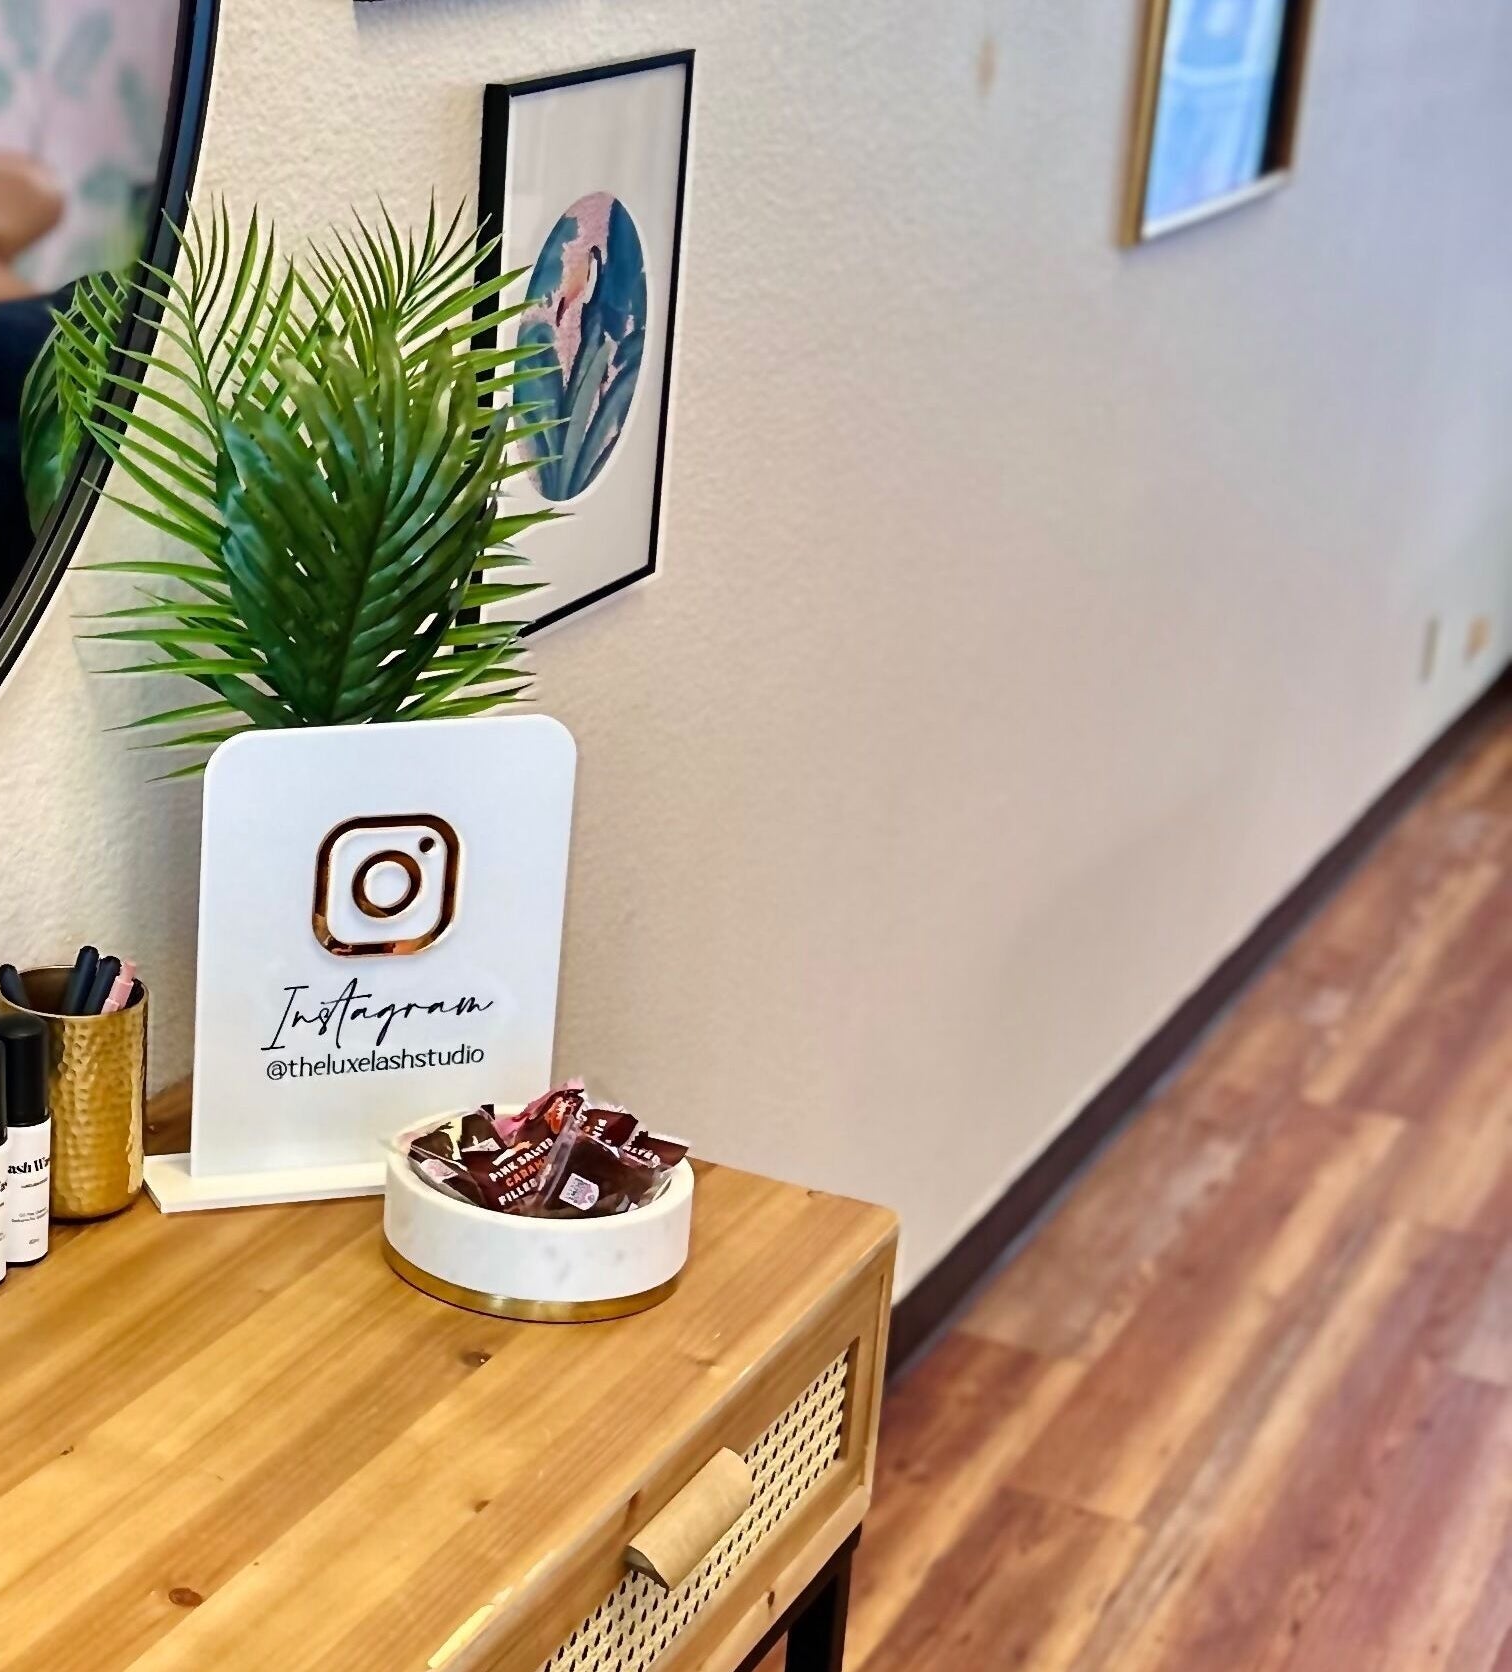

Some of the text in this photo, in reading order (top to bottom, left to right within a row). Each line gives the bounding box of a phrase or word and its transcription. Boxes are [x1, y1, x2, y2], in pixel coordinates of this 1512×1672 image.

[261, 977, 493, 1050] Instagram
[266, 1044, 484, 1081] @theluxelashstudio
[488, 1137, 554, 1182] PINK SALTED
